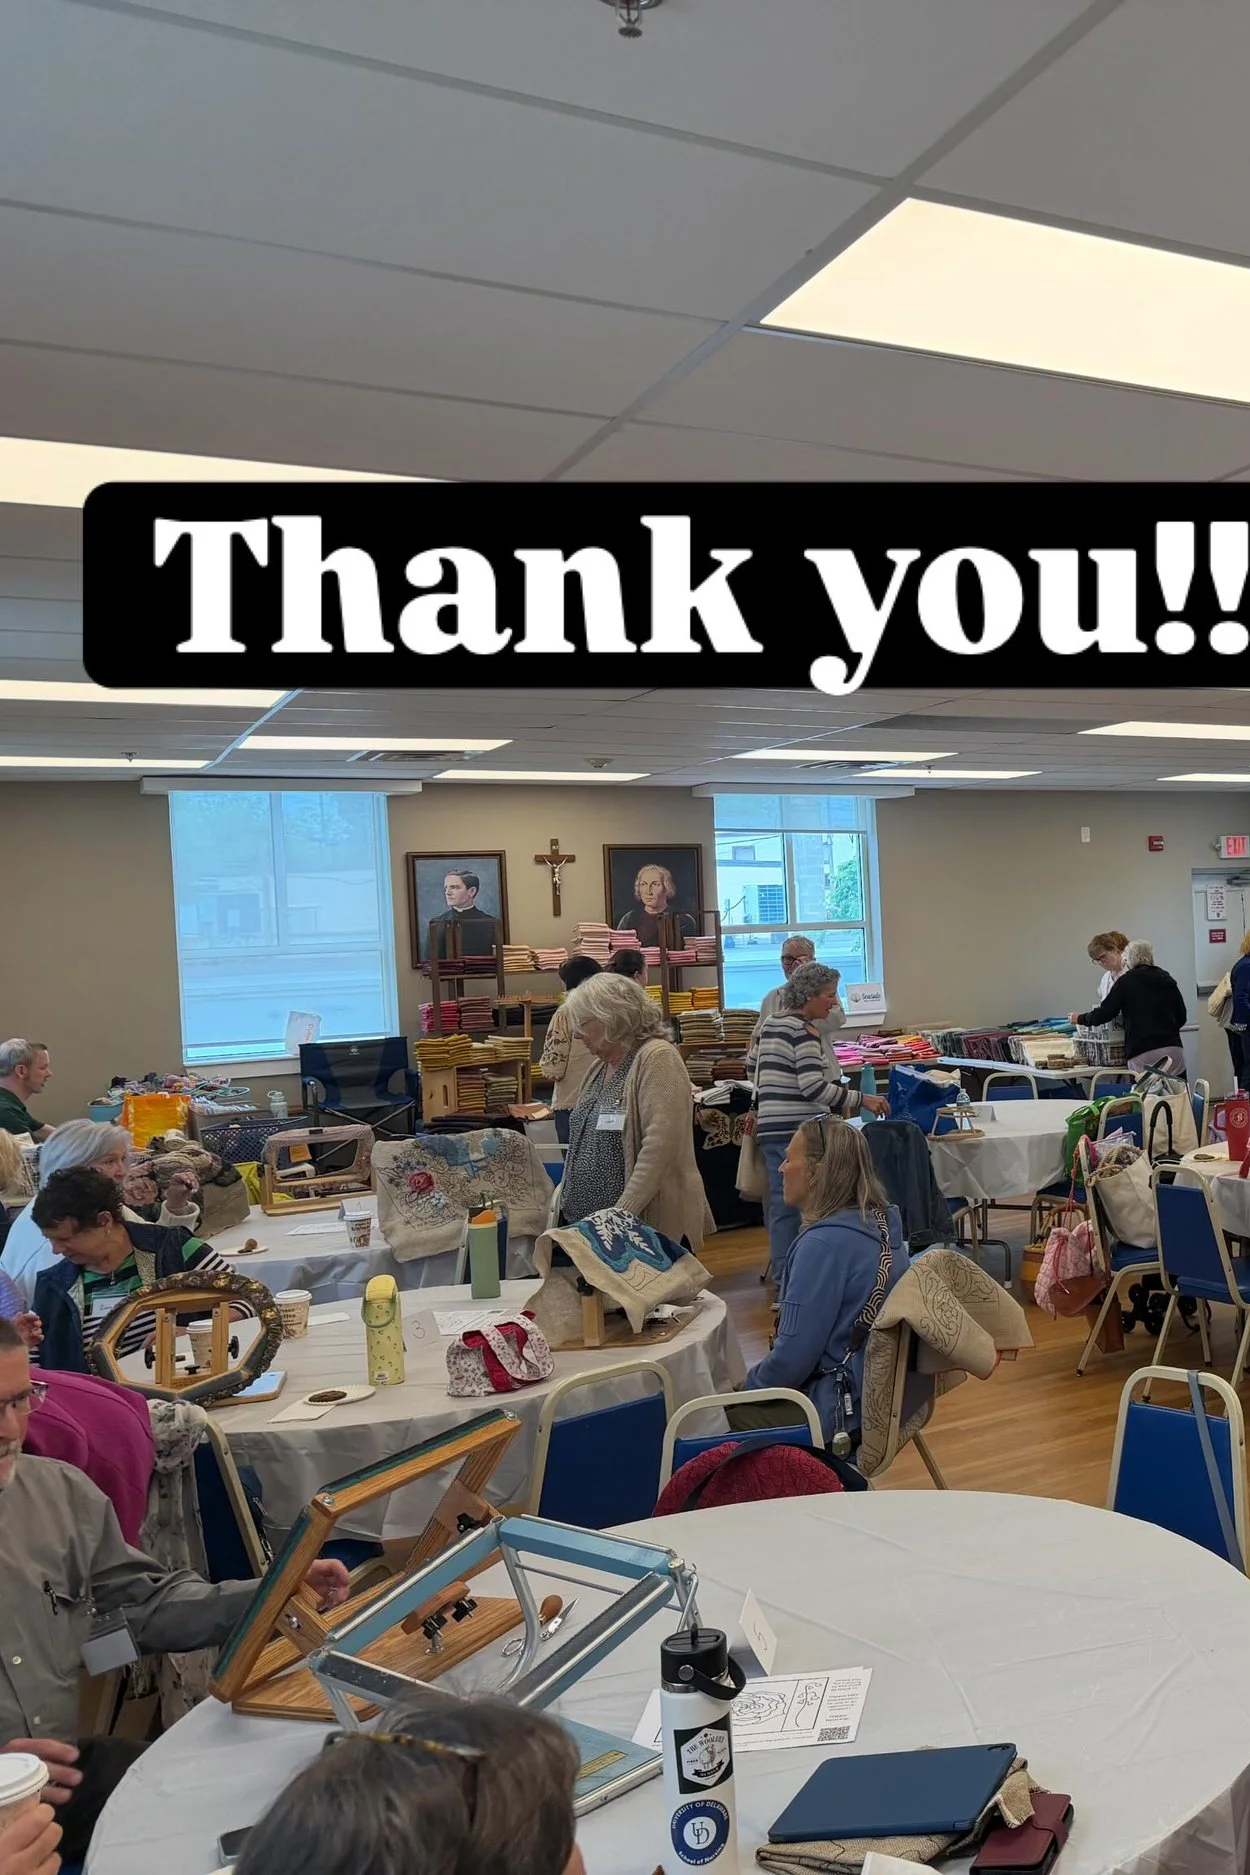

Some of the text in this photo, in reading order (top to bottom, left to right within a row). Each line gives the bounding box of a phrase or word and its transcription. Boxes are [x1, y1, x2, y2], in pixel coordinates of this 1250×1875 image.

[1226, 836, 1247, 857] EXIT
[411, 1319, 426, 1340] 3
[686, 1743, 699, 1755] THE
[672, 1803, 694, 1830] UNIVERSITY
[705, 1801, 729, 1821] DELAWARE
[678, 1850, 696, 1865] School
[703, 1842, 726, 1863] Nursing
